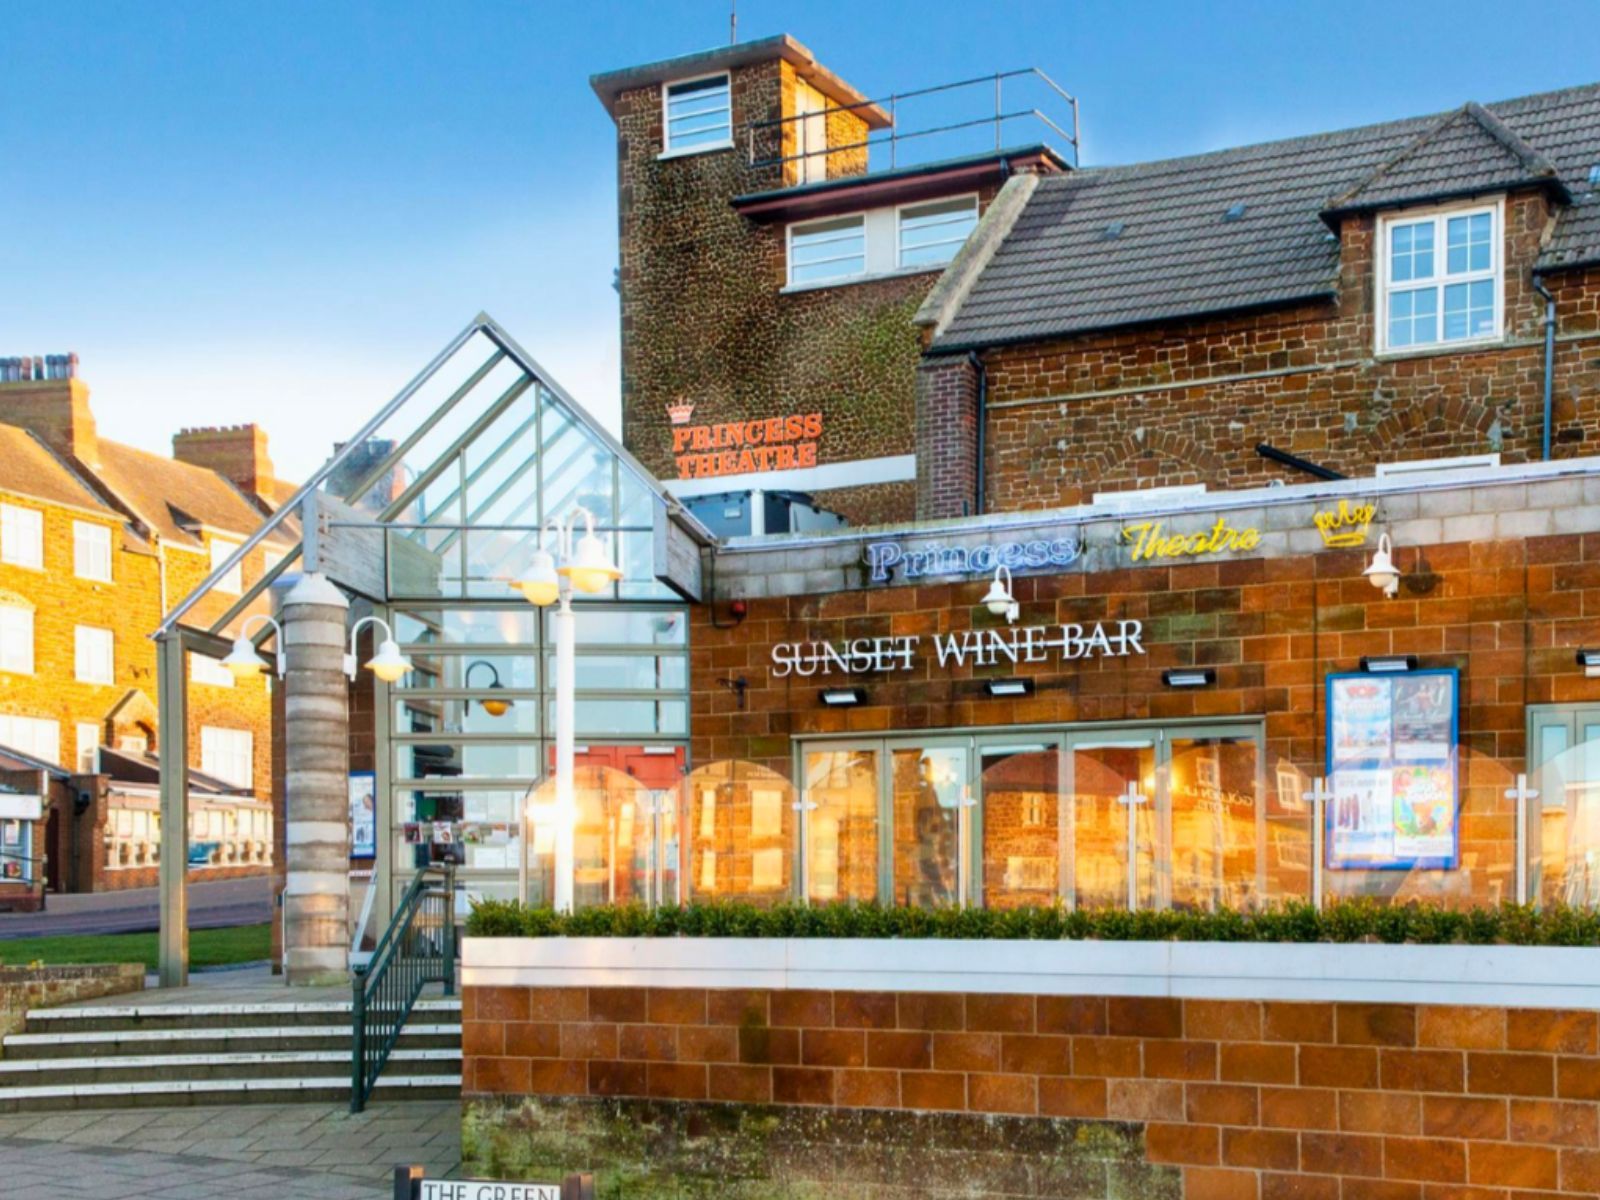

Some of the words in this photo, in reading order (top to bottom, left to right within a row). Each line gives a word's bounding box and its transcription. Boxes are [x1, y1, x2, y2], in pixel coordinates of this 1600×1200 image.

[672, 412, 822, 451] PRINCESS
[676, 442, 817, 479] THEATRE
[868, 537, 1076, 581] Princess
[1122, 518, 1262, 561] Theatre
[771, 635, 919, 678] SUNSET
[932, 625, 1048, 668] WINE
[1060, 619, 1146, 660] BAR
[424, 1183, 467, 1200] THE
[476, 1185, 554, 1200] GREEN
